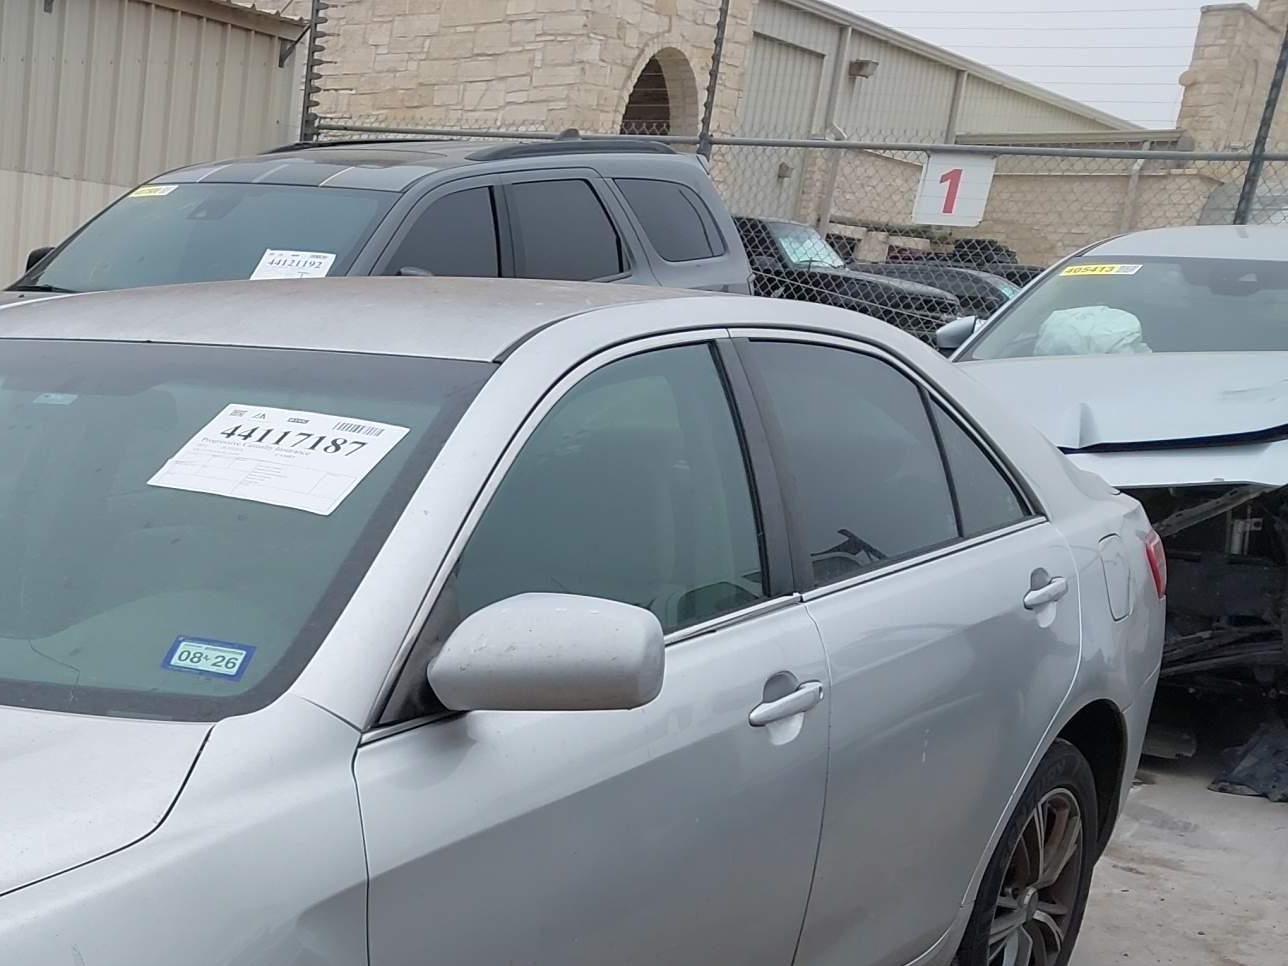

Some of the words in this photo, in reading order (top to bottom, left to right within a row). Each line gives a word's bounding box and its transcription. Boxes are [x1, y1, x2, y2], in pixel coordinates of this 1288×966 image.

[939, 168, 963, 214] 1
[220, 424, 367, 457] 44117187
[178, 650, 203, 664] 08
[210, 655, 238, 670] 26
